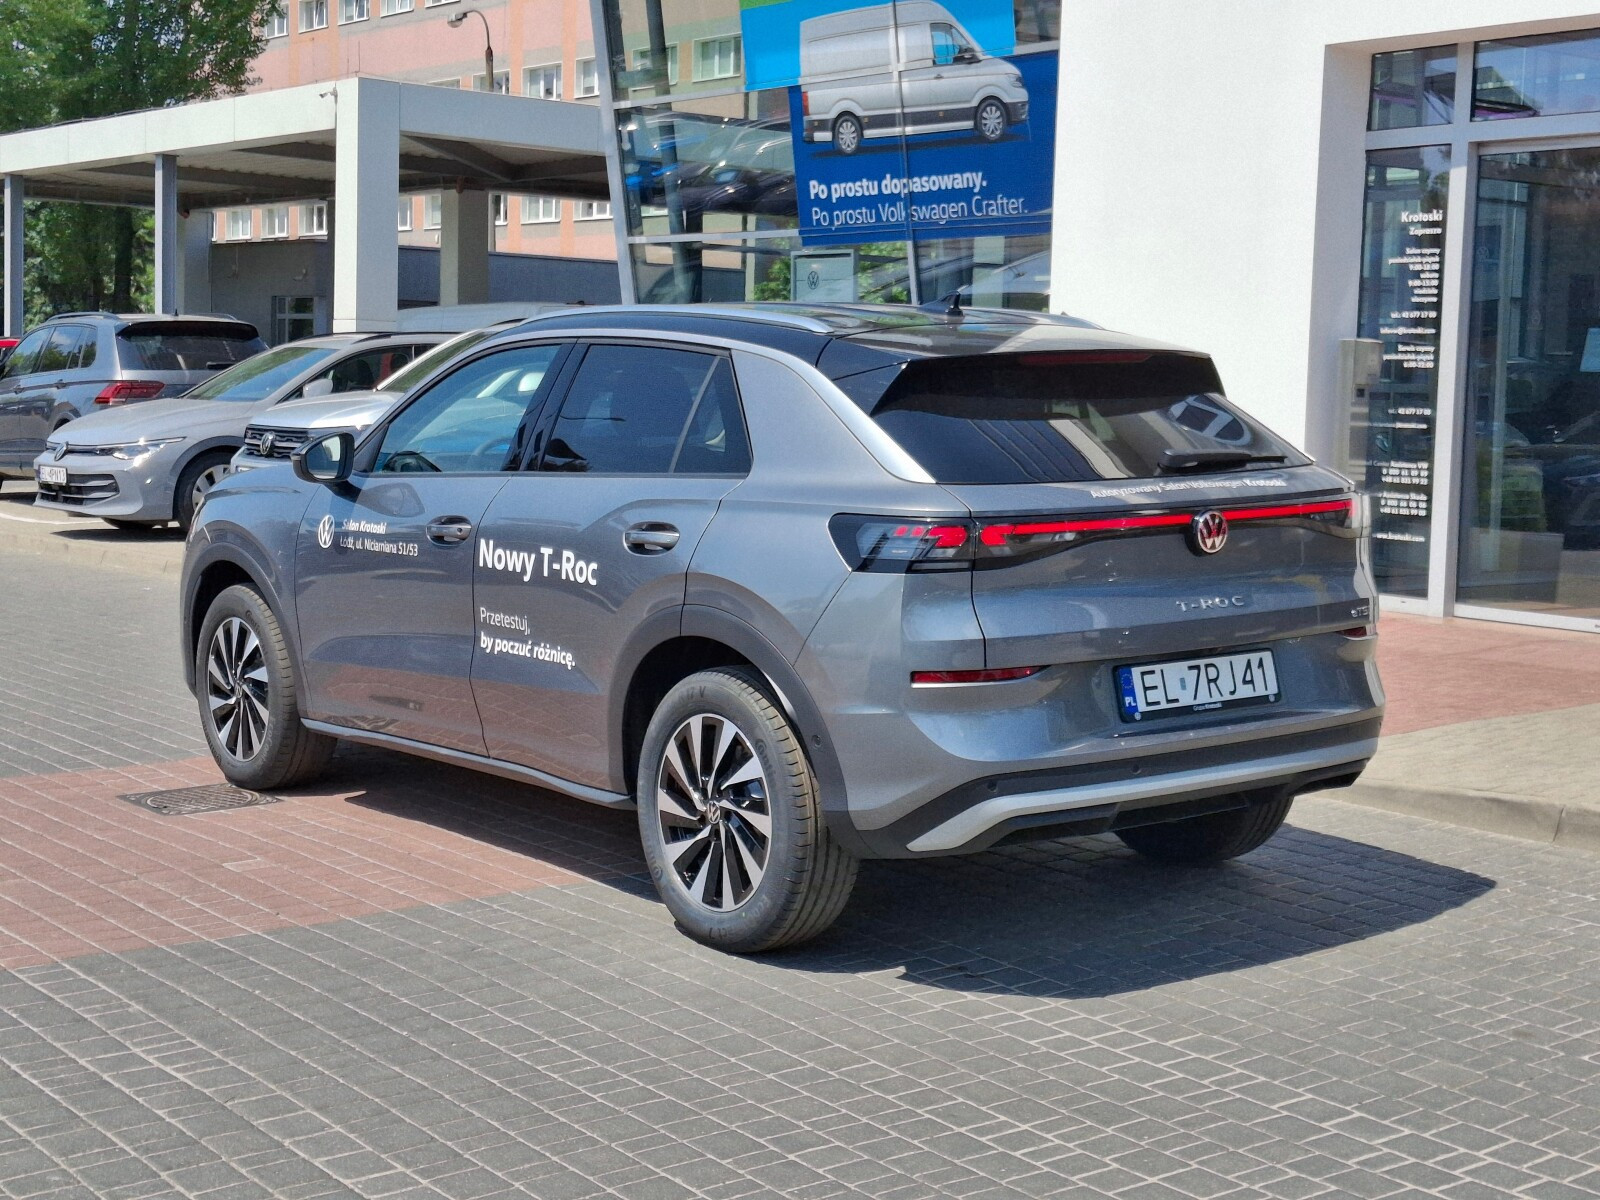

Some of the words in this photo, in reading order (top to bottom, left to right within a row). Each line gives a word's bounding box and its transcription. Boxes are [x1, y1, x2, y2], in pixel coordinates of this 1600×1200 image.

[809, 180, 828, 199] Po
[831, 178, 878, 203] prostu
[881, 171, 987, 198] dopasowany.
[812, 207, 829, 226] Po
[833, 206, 875, 230] prostu
[878, 199, 968, 224] Volkswagen
[971, 194, 1028, 217] Crafter.
[1401, 209, 1443, 222] Krotoski
[1091, 483, 1161, 499] Autoryzowany
[1160, 481, 1190, 491] Salon
[318, 515, 335, 549] VW
[341, 519, 359, 532] Salon
[359, 520, 387, 534] Krotoski
[398, 542, 418, 556] 51/53
[479, 538, 535, 582] Nowy
[541, 547, 598, 586] T-Roc
[1176, 596, 1245, 612] T-ROC
[480, 607, 530, 635] Przetestuj,
[480, 632, 494, 654] by
[494, 637, 532, 658] poczuć
[533, 642, 576, 670] różnicę.
[1140, 669, 1180, 707] EL
[1187, 657, 1268, 701] 7RJ41
[1125, 697, 1136, 706] PL
